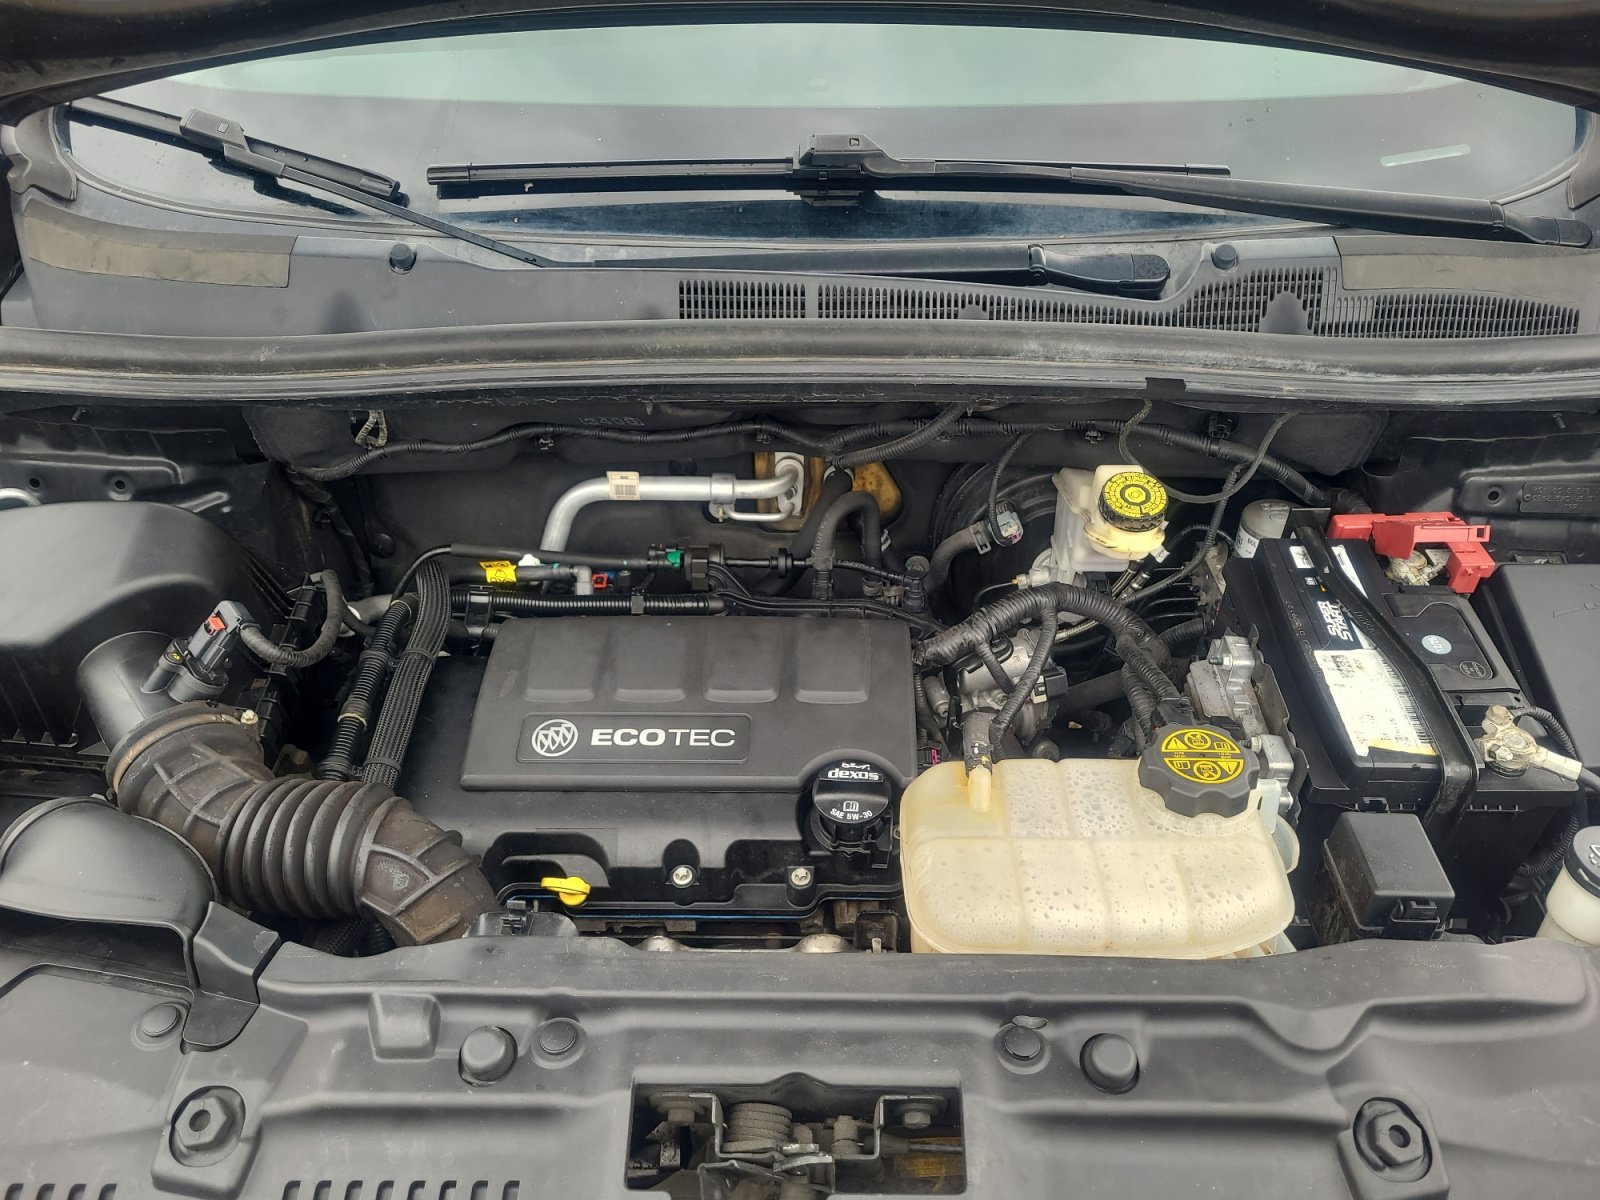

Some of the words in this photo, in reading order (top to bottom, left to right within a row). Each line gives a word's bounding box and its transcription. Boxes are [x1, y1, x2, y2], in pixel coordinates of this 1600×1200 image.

[1317, 601, 1337, 636] SUPER
[1331, 602, 1354, 642] START
[590, 728, 736, 747] ECOTEC
[827, 767, 879, 780] dexos
[829, 808, 845, 819] SAE
[846, 810, 873, 820] 5W-30
